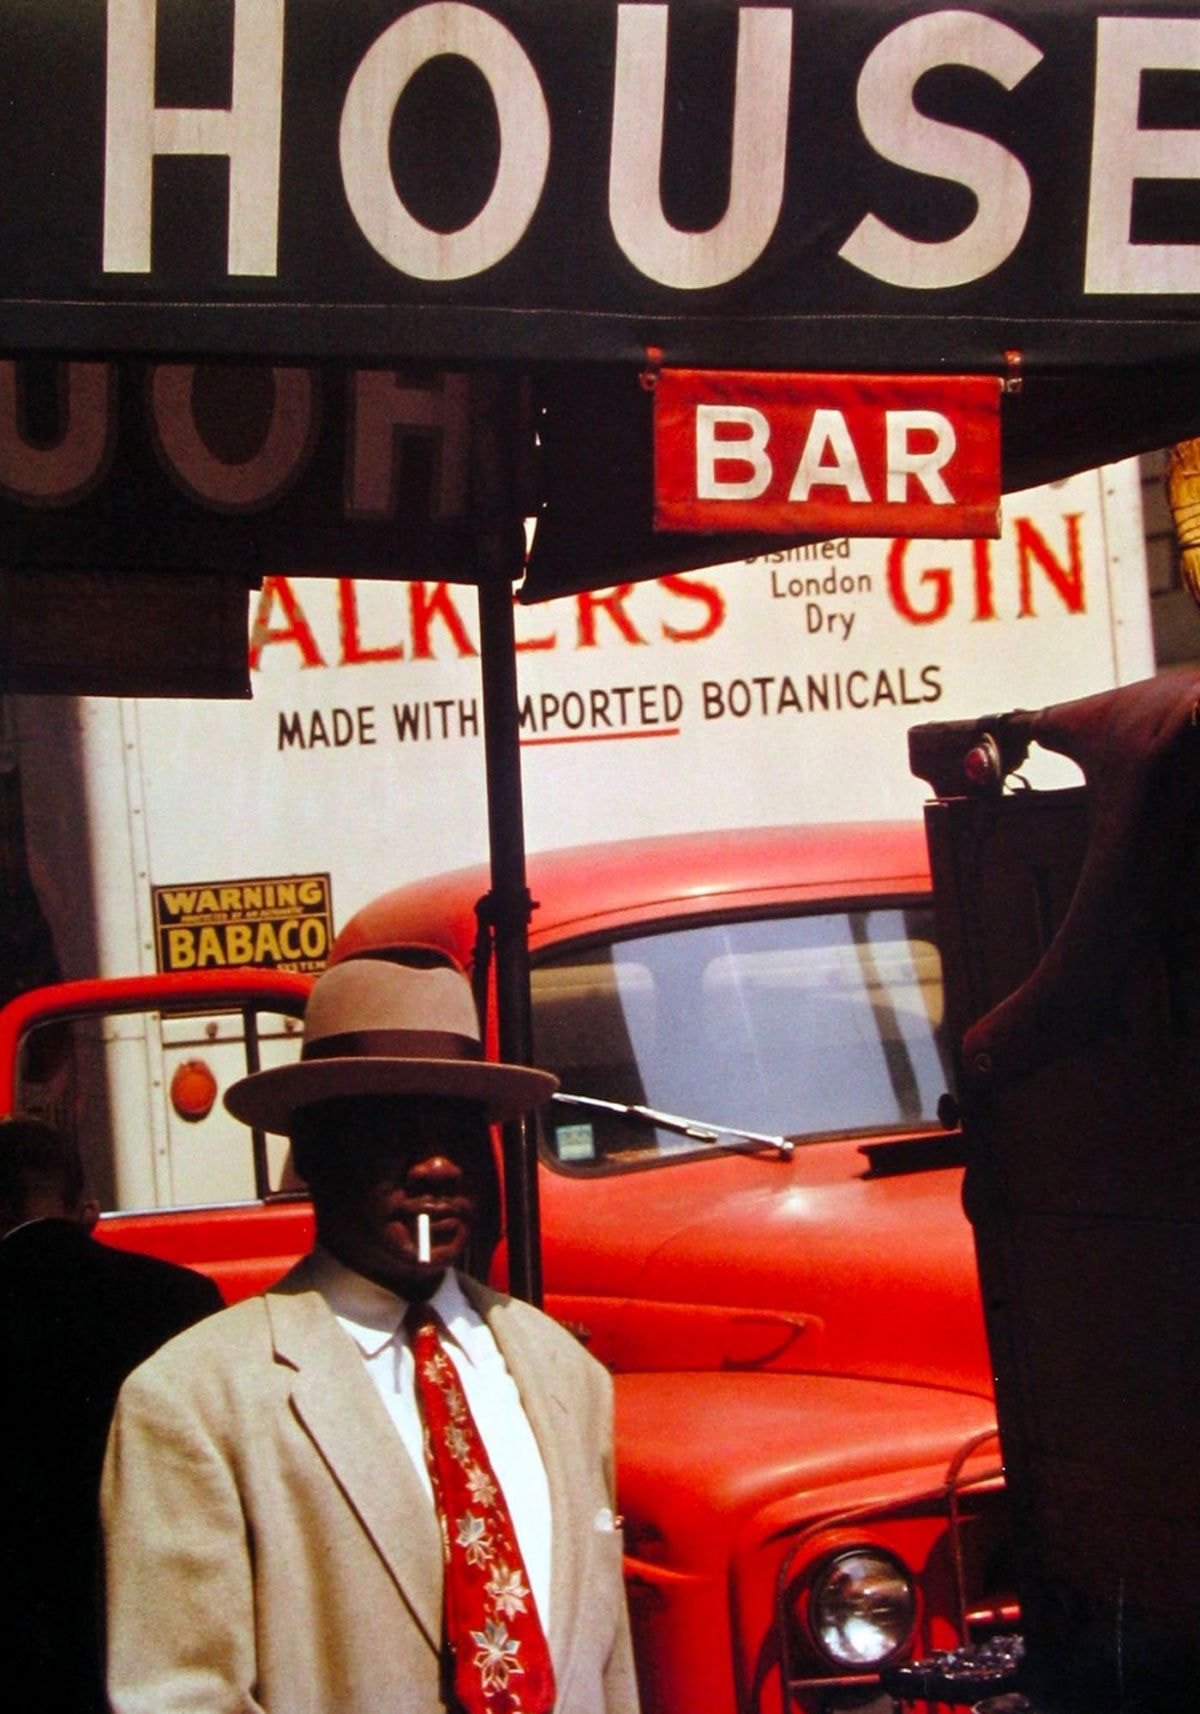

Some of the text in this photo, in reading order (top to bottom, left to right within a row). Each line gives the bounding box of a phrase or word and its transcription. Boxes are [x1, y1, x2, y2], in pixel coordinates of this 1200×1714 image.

[102, 0, 1200, 294] HOUSE
[695, 403, 957, 505] BAR
[770, 566, 873, 599] London
[887, 513, 1085, 625] GIN
[805, 602, 856, 641] Dry
[277, 665, 943, 751] MADE WITH MPORTED BOTANICALS
[161, 880, 323, 916] WARNING
[168, 918, 327, 970] BABACO
